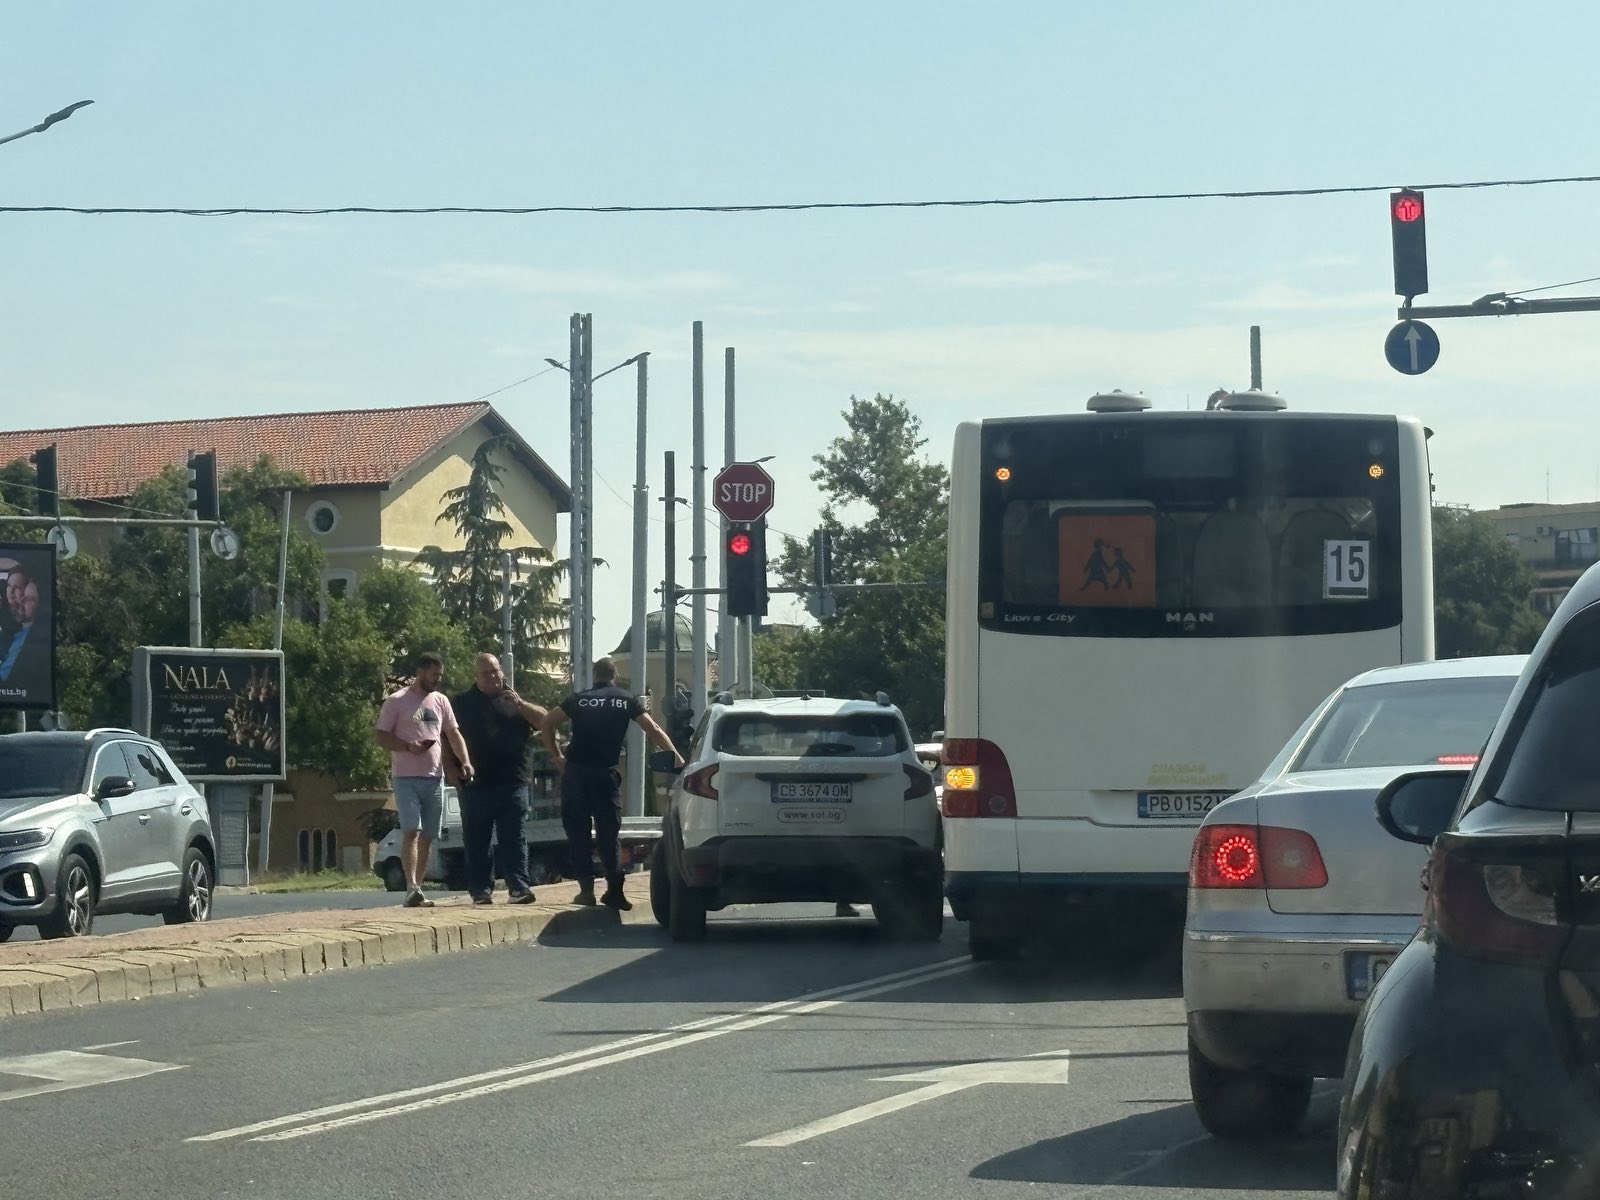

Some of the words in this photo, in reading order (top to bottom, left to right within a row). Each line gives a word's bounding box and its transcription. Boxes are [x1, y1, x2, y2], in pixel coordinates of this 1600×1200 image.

[721, 482, 766, 503] STOP
[1330, 545, 1364, 582] 15
[1004, 613, 1041, 622] Lions
[1047, 613, 1076, 623] City
[1166, 612, 1214, 622] MAN
[161, 663, 232, 692] NALA
[610, 698, 627, 709] 161
[780, 785, 797, 797] CB
[799, 785, 830, 797] 3674
[1149, 796, 1170, 811] PB
[1174, 796, 1213, 811] 0152
